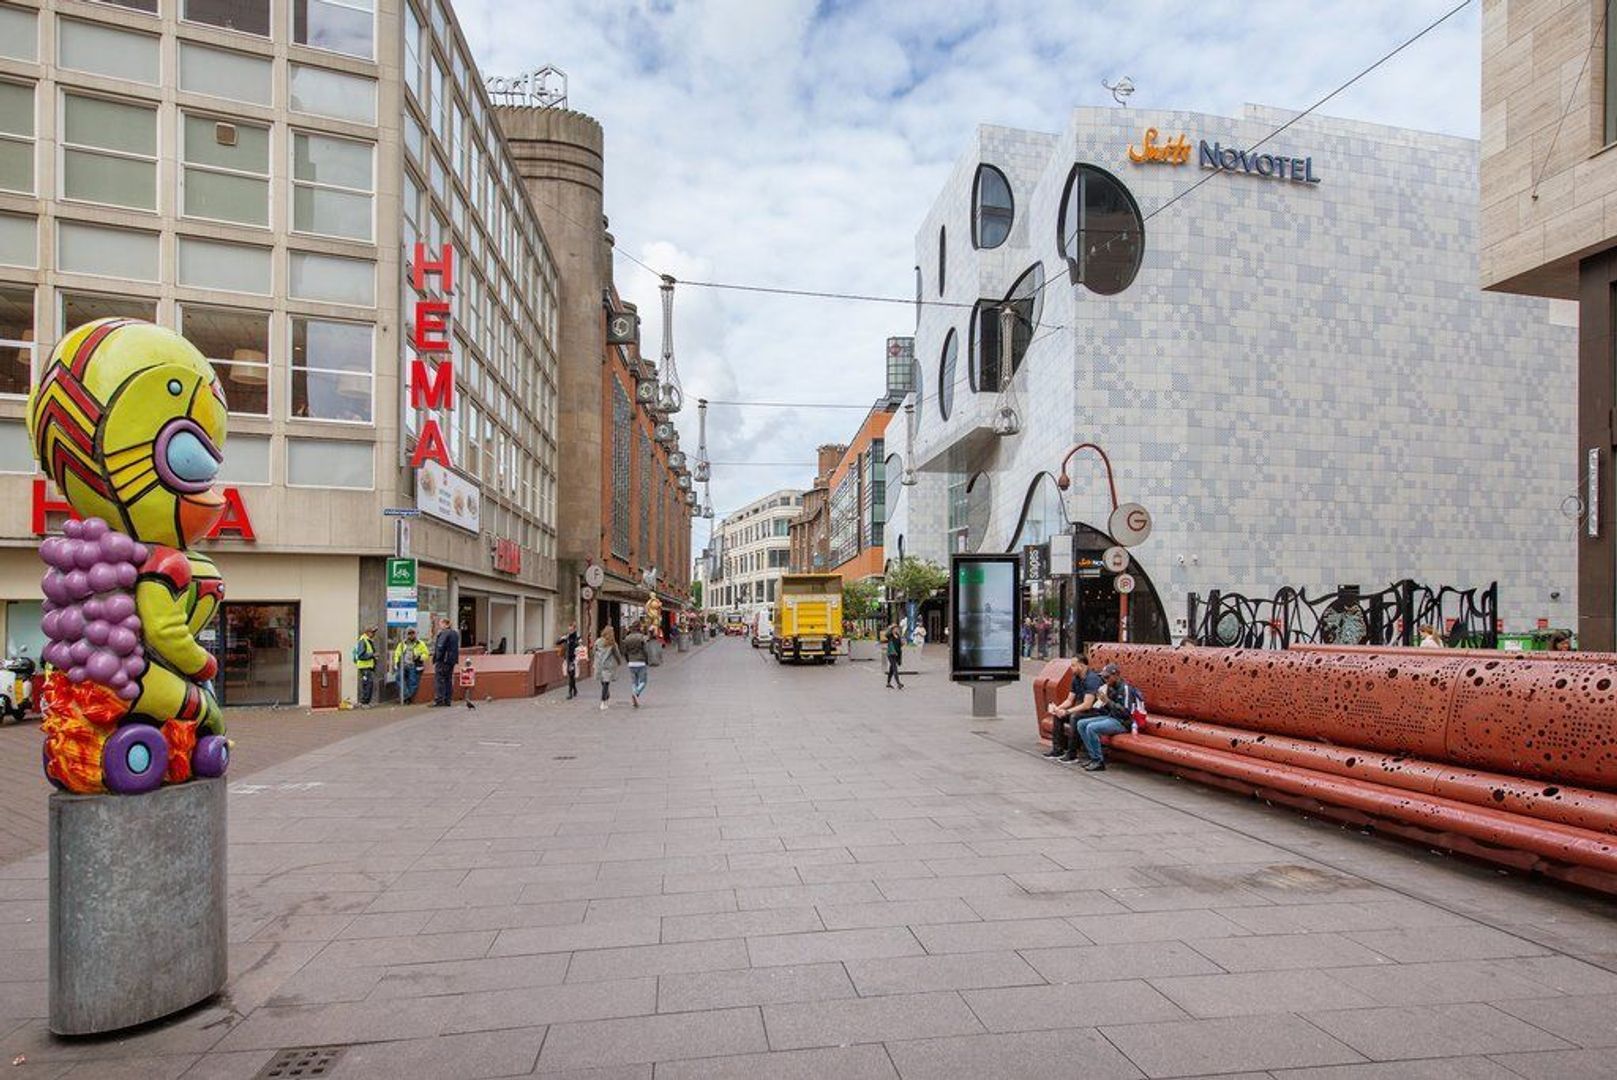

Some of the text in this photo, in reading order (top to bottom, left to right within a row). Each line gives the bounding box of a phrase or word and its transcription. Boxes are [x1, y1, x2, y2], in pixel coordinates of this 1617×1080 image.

[1199, 139, 1321, 183] NOVOTEL
[410, 241, 455, 469] HEMA
[1127, 509, 1148, 532] G
